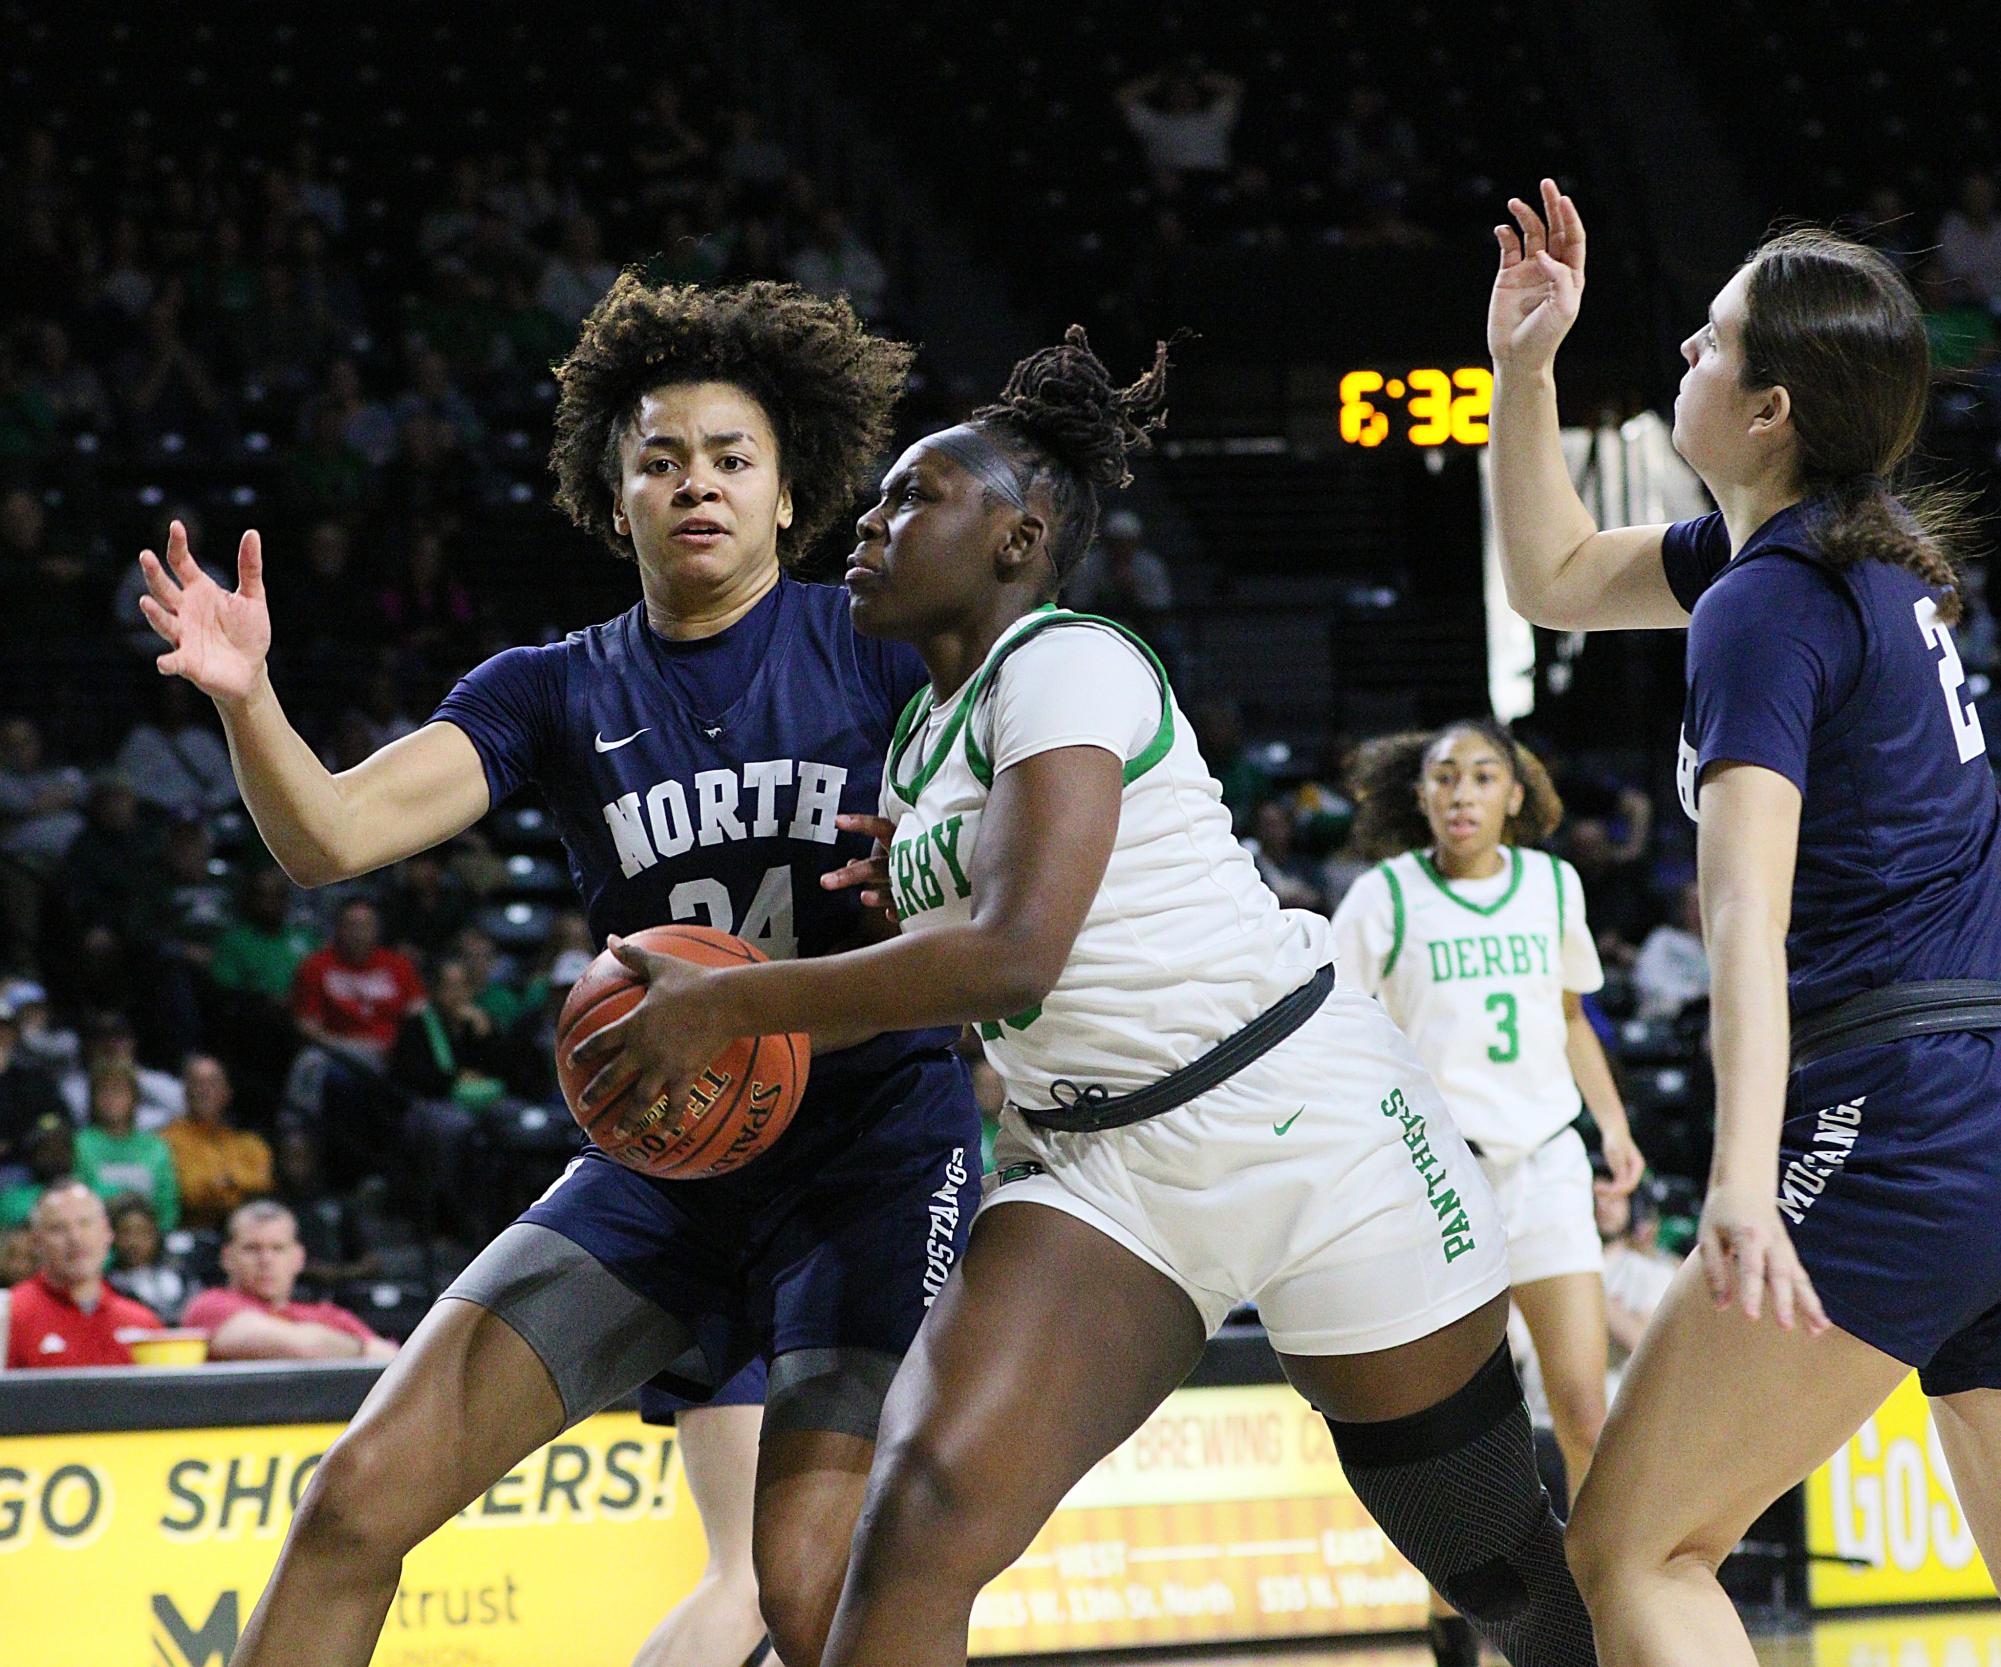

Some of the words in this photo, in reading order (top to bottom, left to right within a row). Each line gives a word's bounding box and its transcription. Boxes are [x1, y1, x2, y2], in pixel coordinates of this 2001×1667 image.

[1340, 368, 1494, 447] 6:32
[602, 759, 848, 880] NORTH
[1427, 933, 1550, 983] DERBY
[1485, 991, 1520, 1064] 3
[1381, 1088, 1475, 1264] PANTHERS
[1134, 1411, 1283, 1471] BREWING
[397, 1573, 520, 1629] trust
